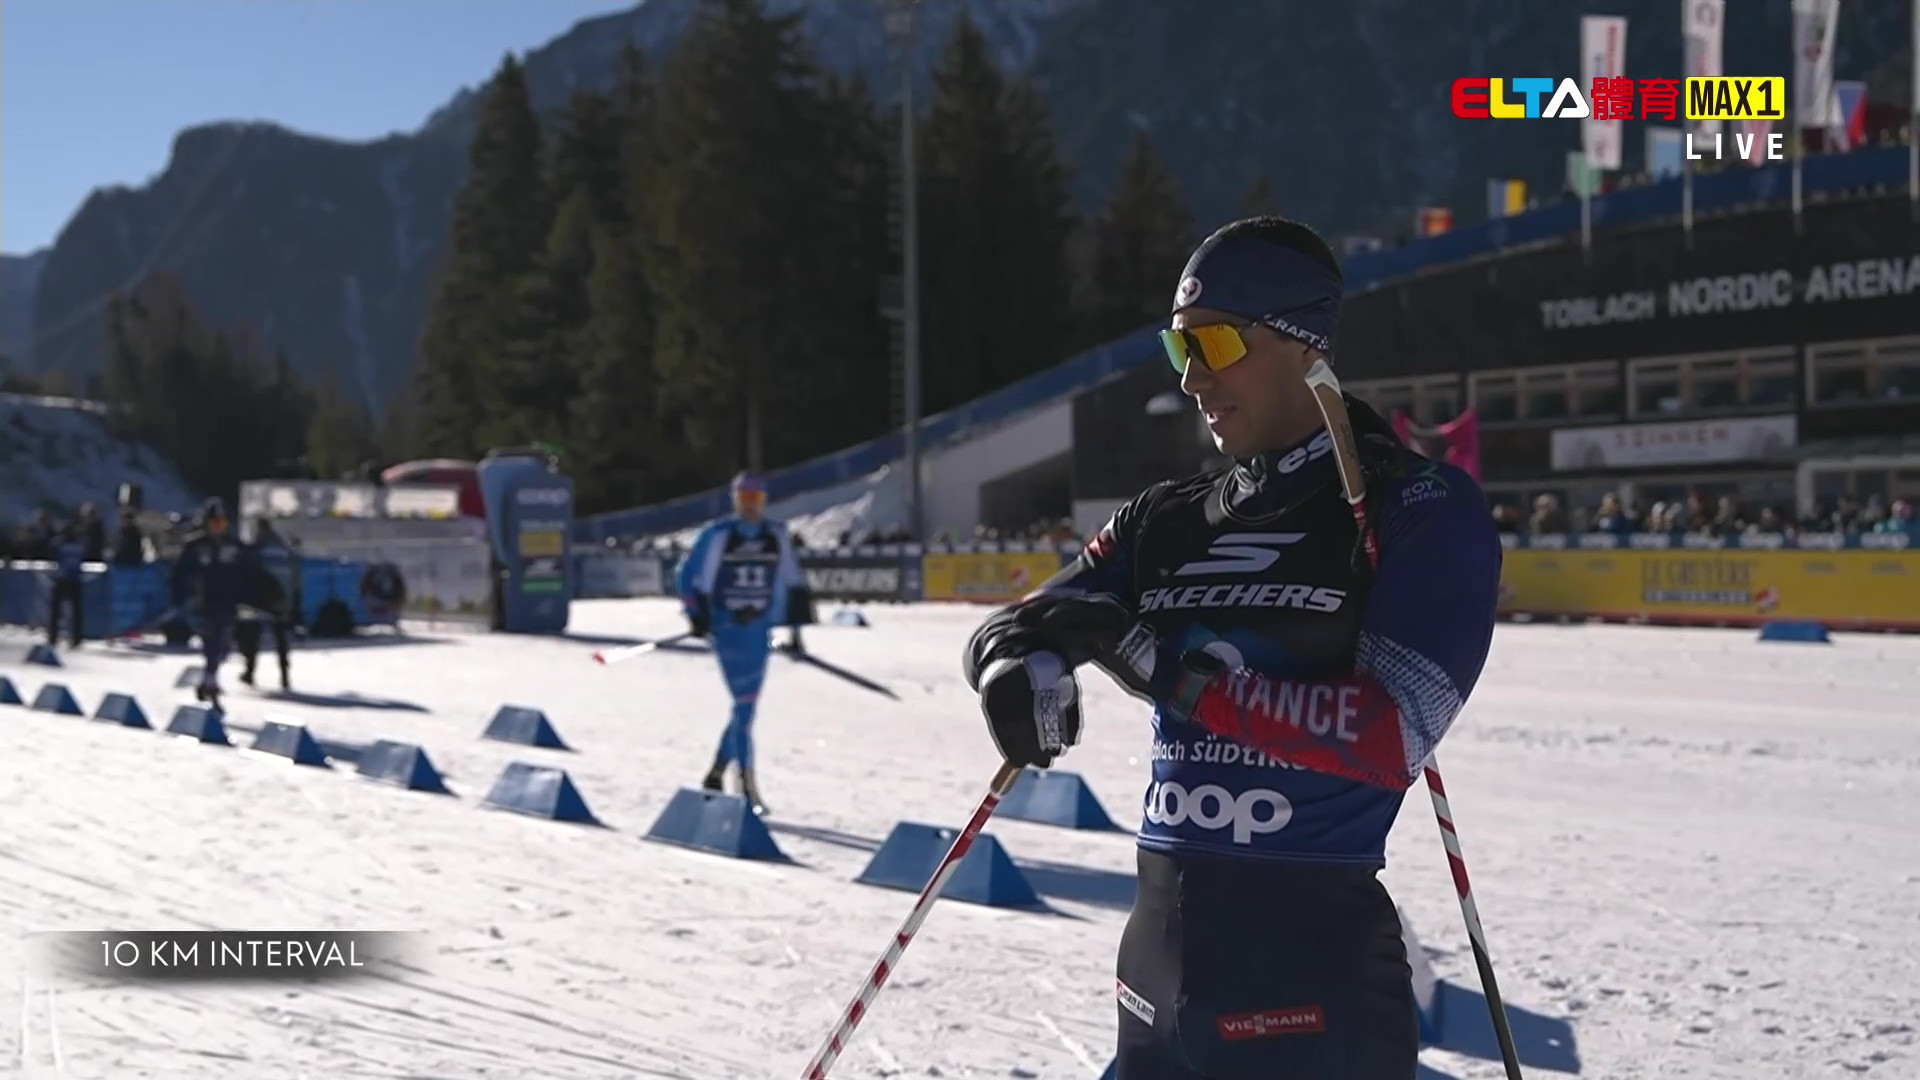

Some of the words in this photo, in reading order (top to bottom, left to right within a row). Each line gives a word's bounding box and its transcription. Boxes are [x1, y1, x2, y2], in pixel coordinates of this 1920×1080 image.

[1541, 291, 1656, 329] TOBLACH
[1668, 269, 1794, 318] NORDIC
[1804, 254, 1920, 303] ARENA
[1277, 430, 1334, 475] es
[1402, 480, 1434, 498] ROY
[734, 566, 768, 588] 11
[1139, 583, 1347, 615] SKECHERS
[1223, 660, 1361, 743] RANCE
